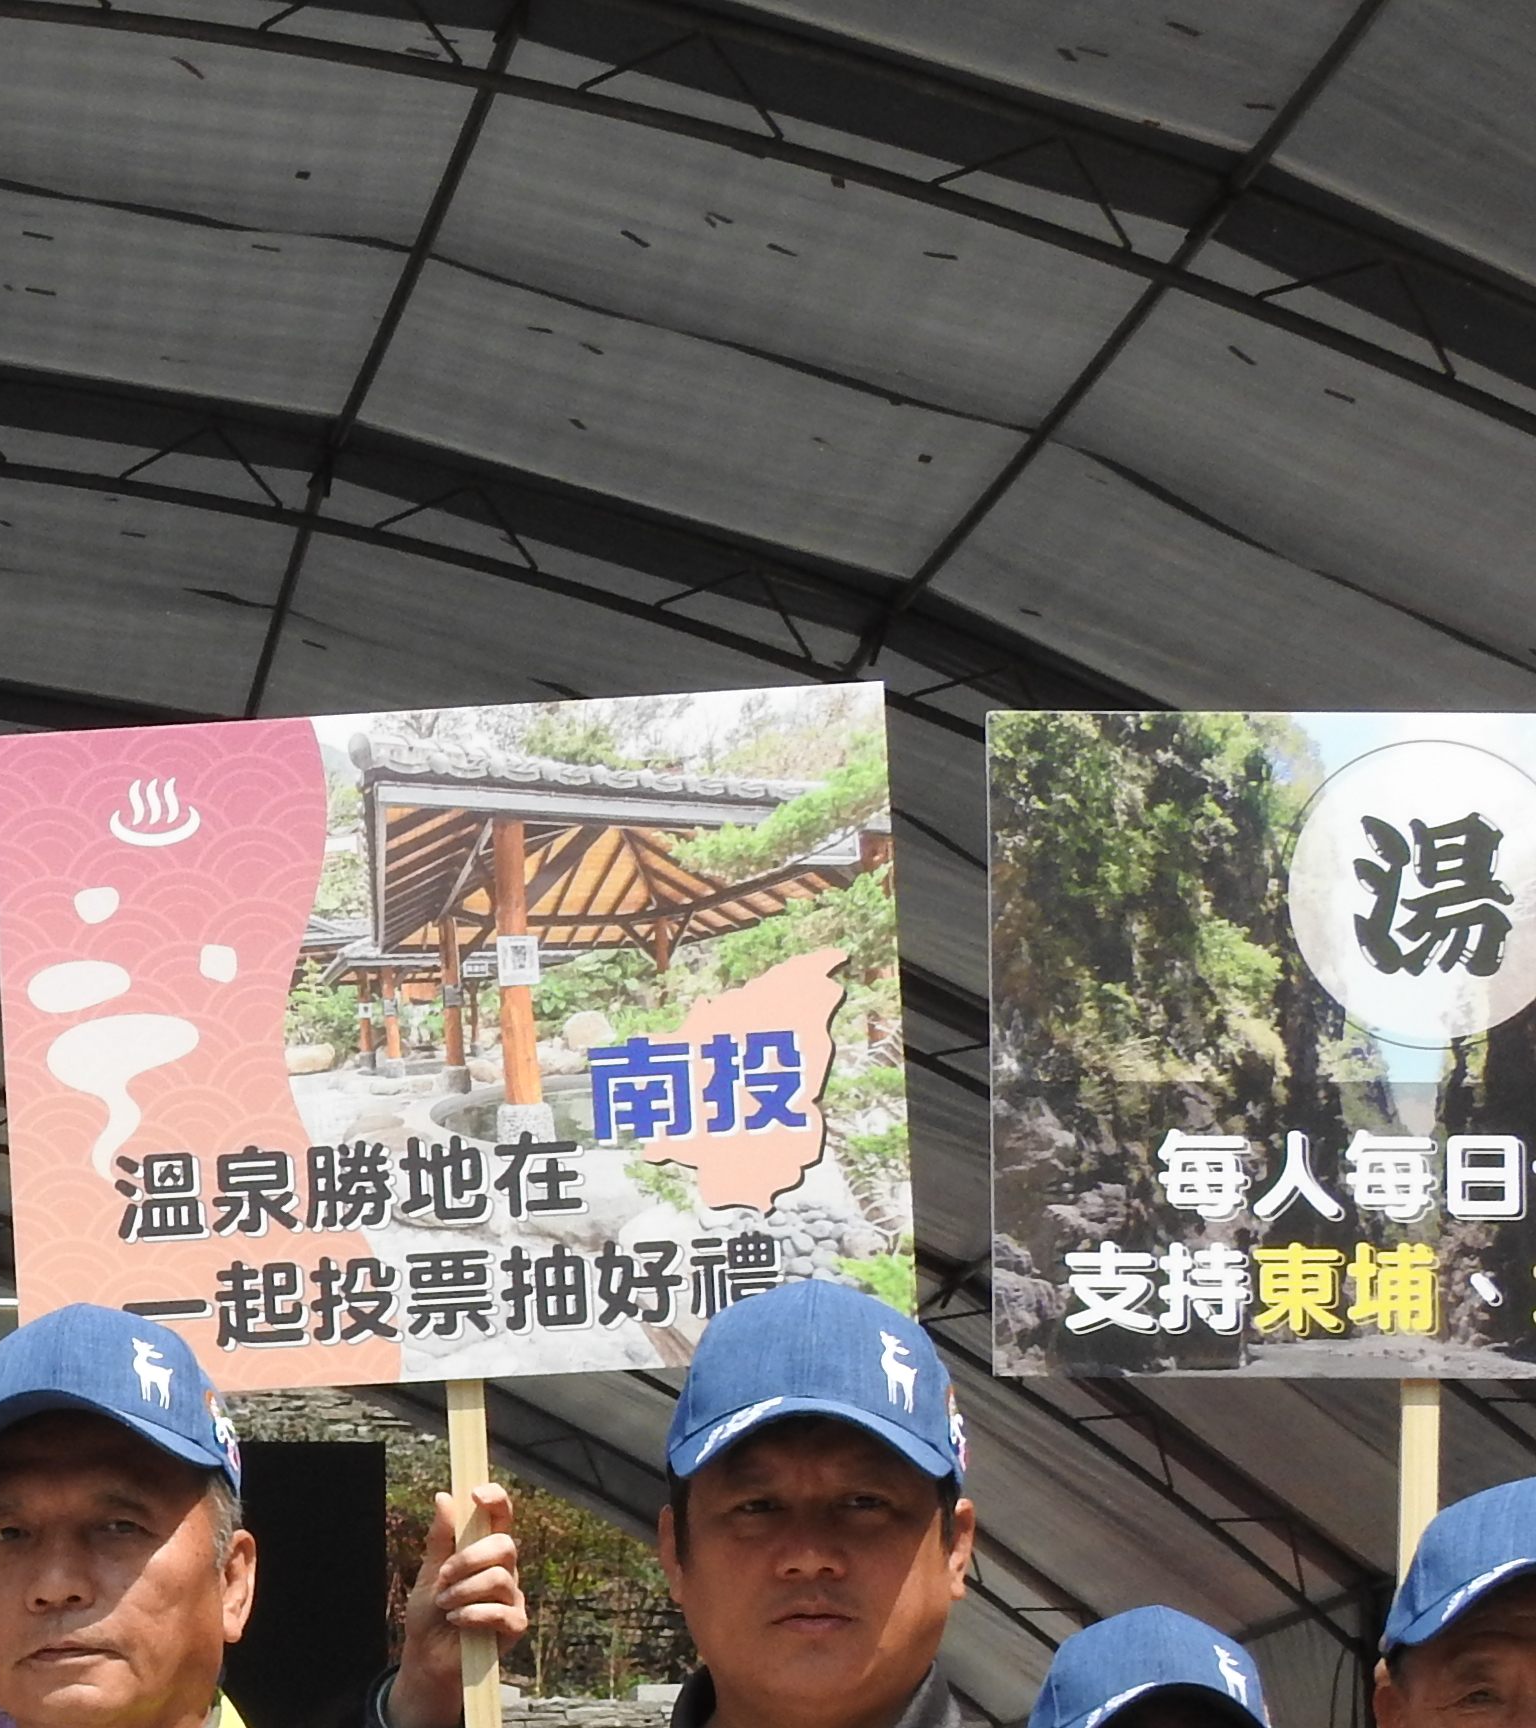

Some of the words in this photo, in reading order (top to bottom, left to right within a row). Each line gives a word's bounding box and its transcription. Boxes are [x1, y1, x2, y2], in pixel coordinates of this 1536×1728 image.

[1353, 811, 1515, 978] 湯
[588, 1029, 813, 1146] 南投
[113, 1131, 588, 1245] 溫泉勝地在
[1157, 1128, 1536, 1223] 每人每日
[1064, 1241, 1536, 1336] 支持東埔、
